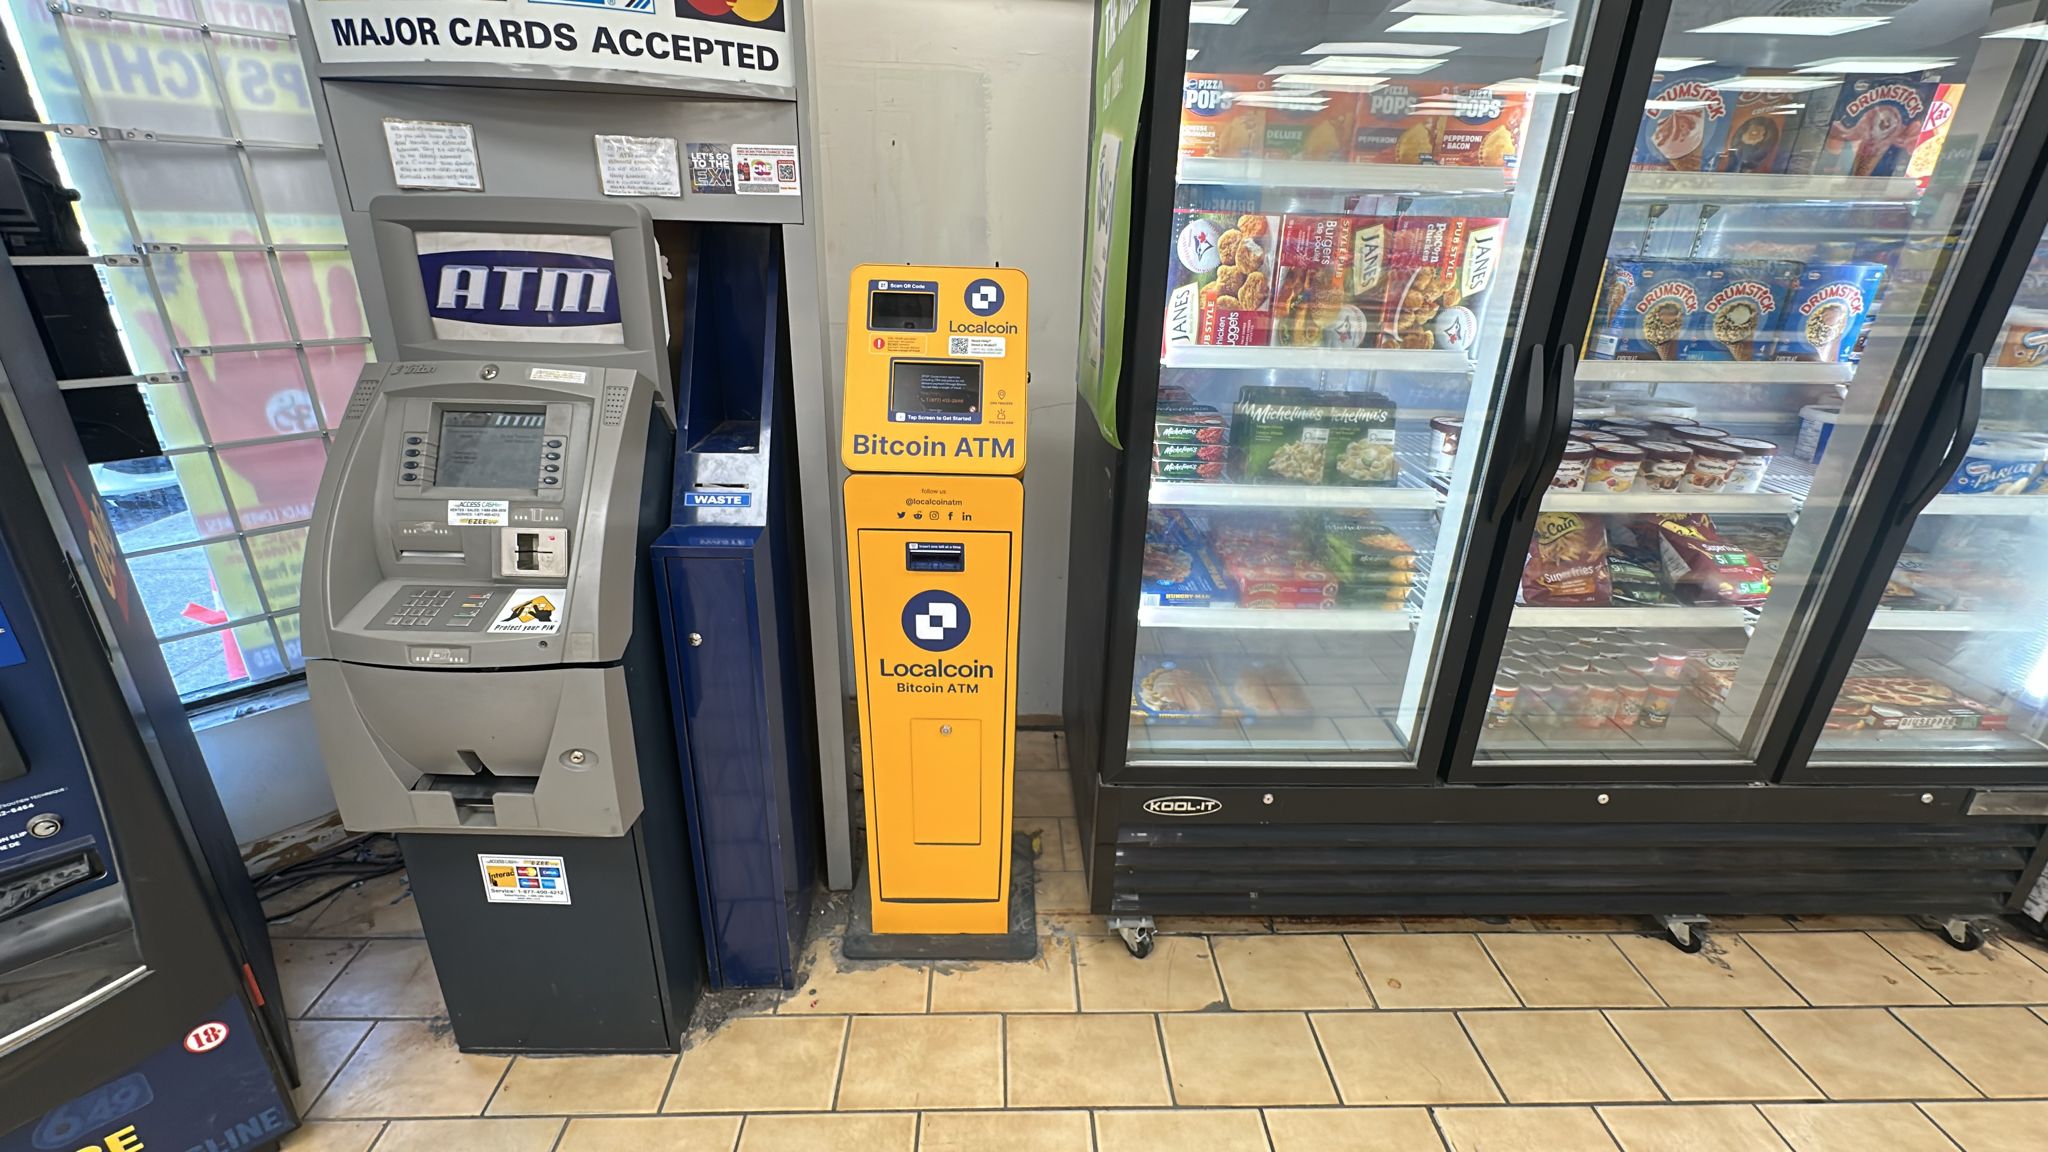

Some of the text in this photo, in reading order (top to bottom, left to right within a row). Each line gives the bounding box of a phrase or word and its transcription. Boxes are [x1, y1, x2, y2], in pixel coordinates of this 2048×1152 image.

[331, 17, 780, 72] MAJOR CARDS ACCEPTED
[1185, 80, 1233, 109] PIZZA POPS
[1384, 86, 1408, 96] PIZZA
[1846, 84, 1924, 118] DRUMSTICK
[1370, 96, 1418, 115] POPS
[1454, 99, 1502, 118] POPS
[1923, 101, 1950, 131] Kat
[1443, 134, 1483, 143] PEPPERONI
[1446, 142, 1471, 150] BACON
[691, 152, 714, 160] LET'S
[692, 159, 729, 169] TO THE
[693, 167, 732, 187] EX!
[1321, 220, 1337, 265] Burgers
[1335, 220, 1350, 279] STYLE PUB
[1422, 223, 1434, 262] chicken
[1430, 222, 1447, 263] Popcorn
[1445, 221, 1463, 279] PUB STYLE
[1361, 233, 1380, 288] JANES
[1469, 236, 1493, 290] JANES
[436, 264, 612, 313] ATM
[1636, 282, 1698, 315] DRUMSTICK
[1704, 282, 1776, 314] DRUMSTICK
[1799, 284, 1864, 316] DRUMSTICK
[1171, 289, 1190, 342] JANES
[1205, 300, 1215, 332] STYLE
[949, 320, 1018, 334] Localcoin
[908, 414, 916, 422] Tap
[1252, 404, 1324, 424] Michelina's
[853, 433, 1015, 458] Bitcoin ATM
[694, 495, 742, 505] WASTE
[922, 487, 938, 495] follow
[906, 498, 963, 506] @localcoinatm
[879, 658, 994, 678] Localcoin
[896, 682, 979, 694] Bitcoin ATM
[1150, 801, 1216, 811] KOOL-IT
[9, 830, 28, 841] SLIP
[489, 870, 515, 881] Interac
